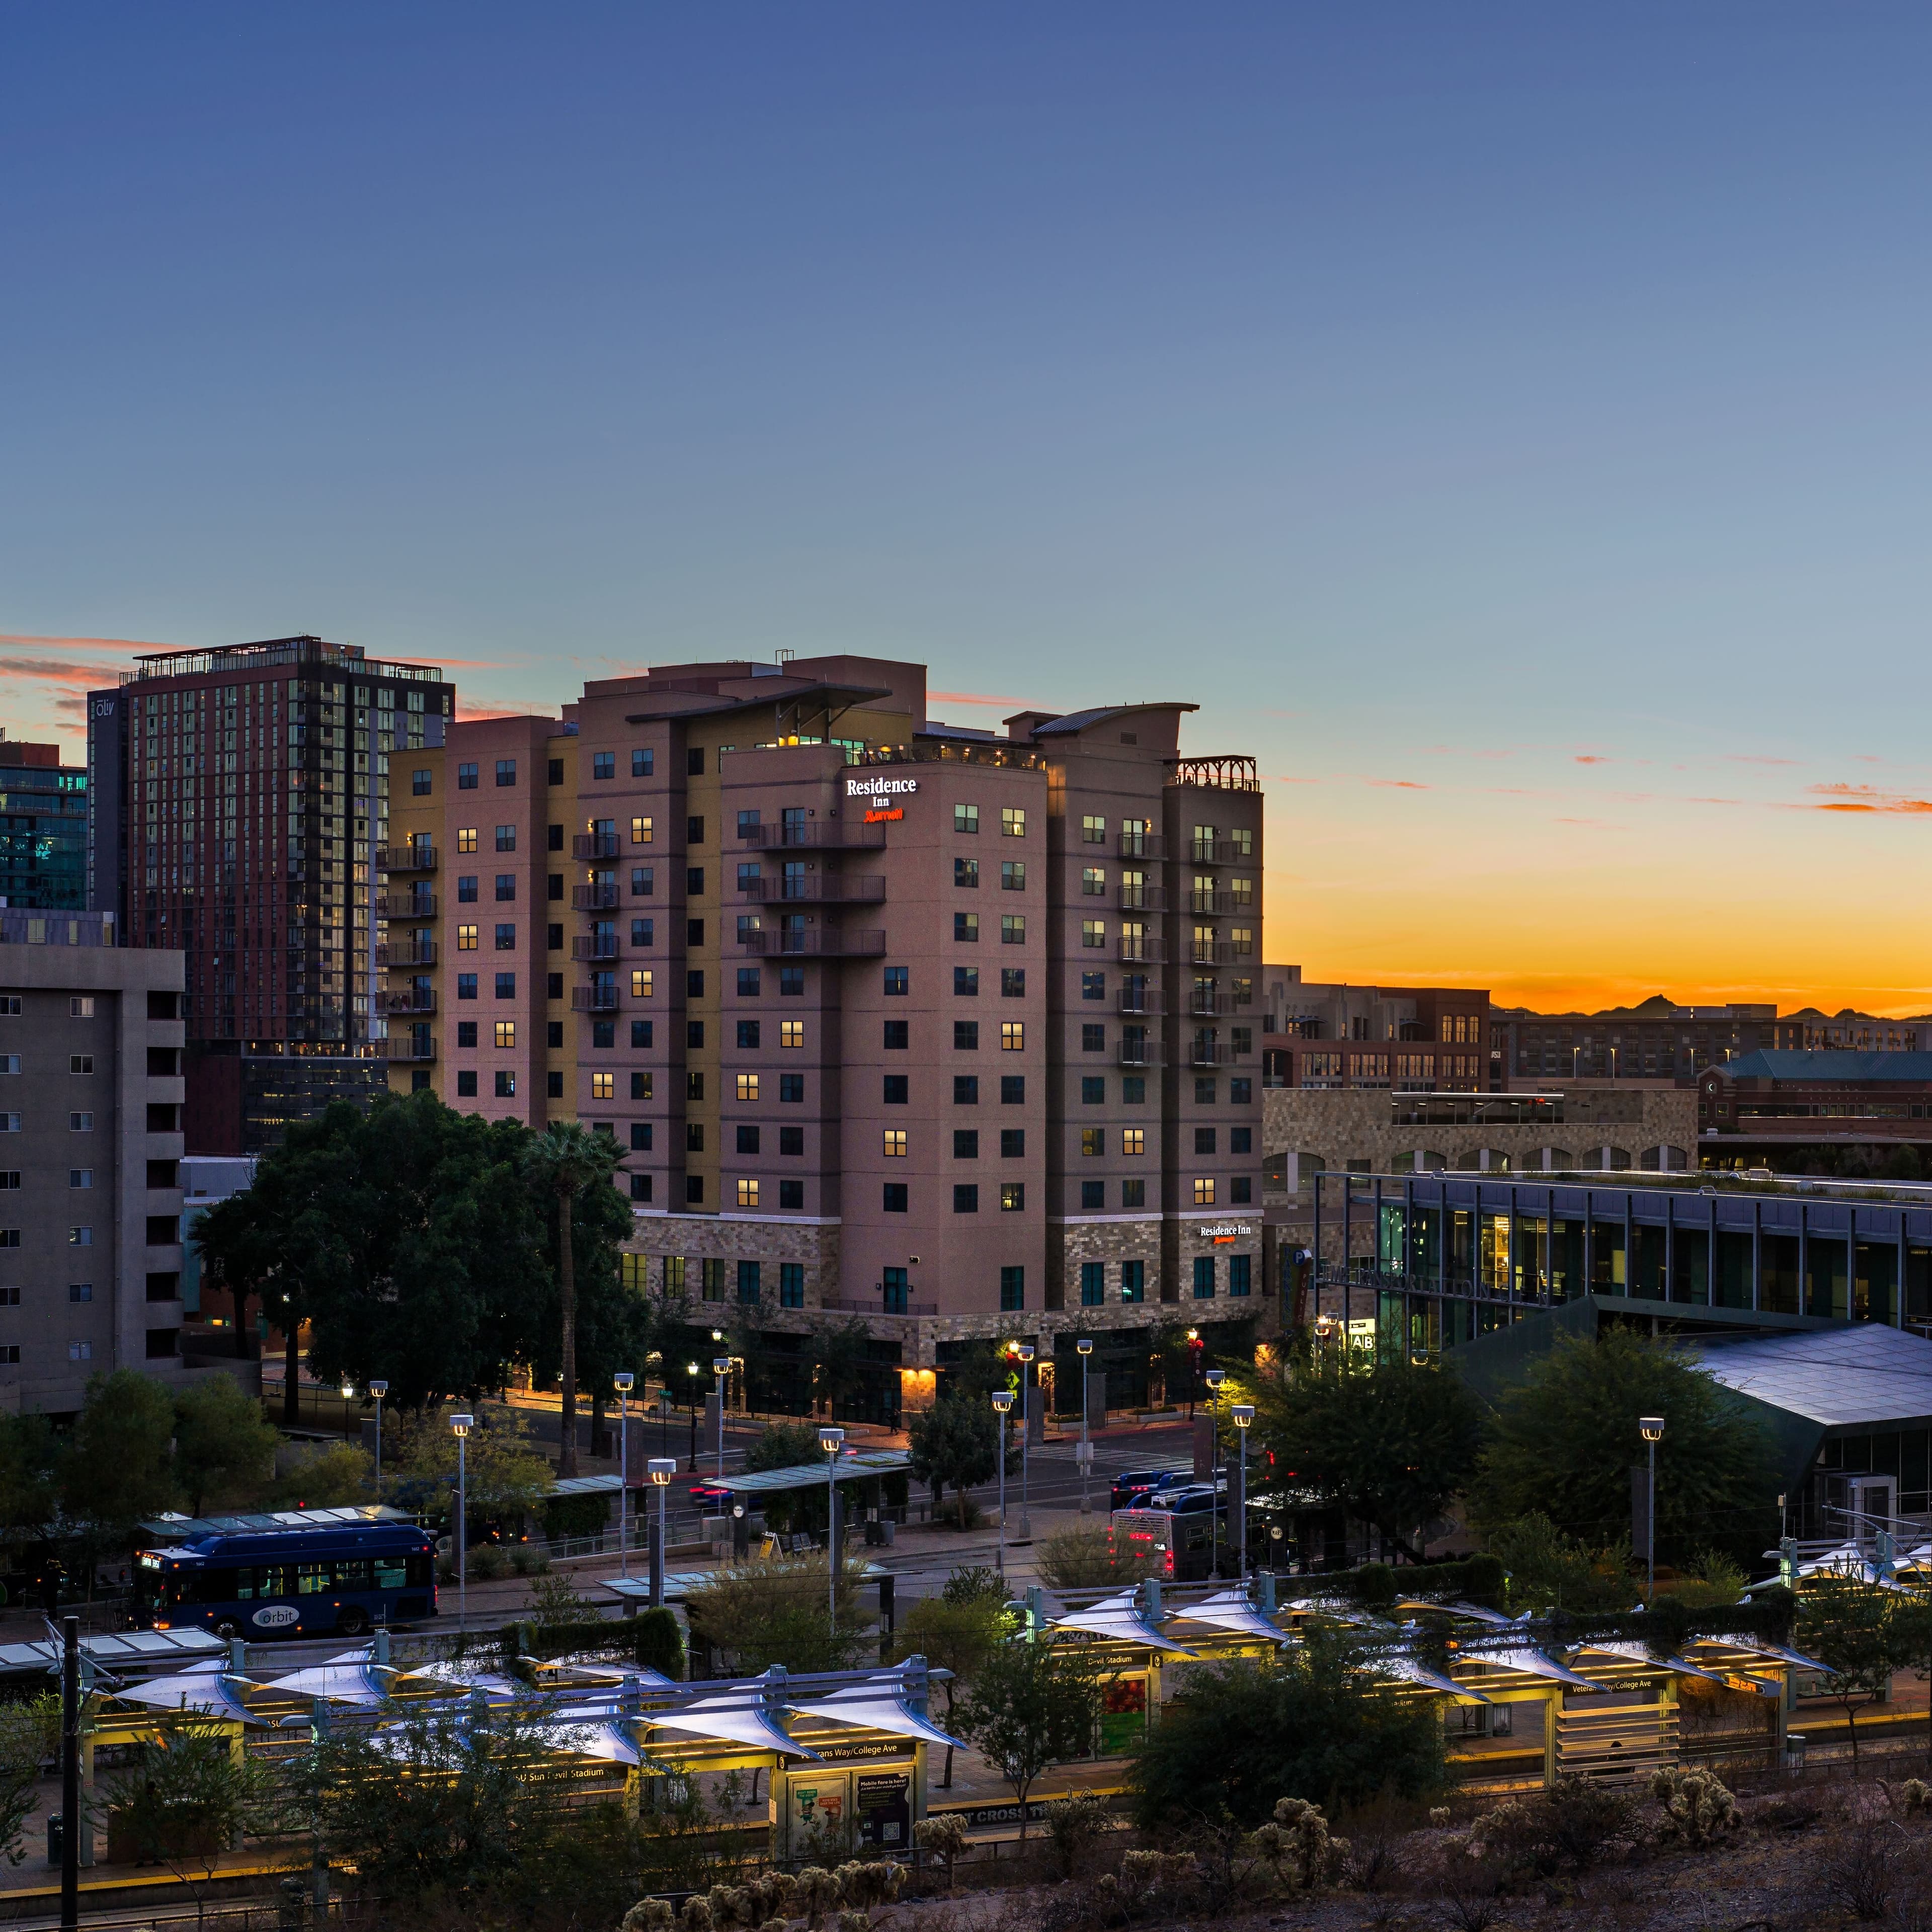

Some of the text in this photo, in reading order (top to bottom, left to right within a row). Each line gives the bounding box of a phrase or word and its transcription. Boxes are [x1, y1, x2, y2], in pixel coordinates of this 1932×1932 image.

[847, 777, 917, 795] Residence
[873, 796, 890, 807] Inn
[1200, 1225, 1251, 1236] Residence Inn
[1282, 1245, 1292, 1325] PARKING
[263, 1611, 295, 1624] orbit
[835, 1745, 881, 1757] Way/College
[529, 1773, 544, 1782] Sun
[571, 1768, 604, 1778] Stadium
